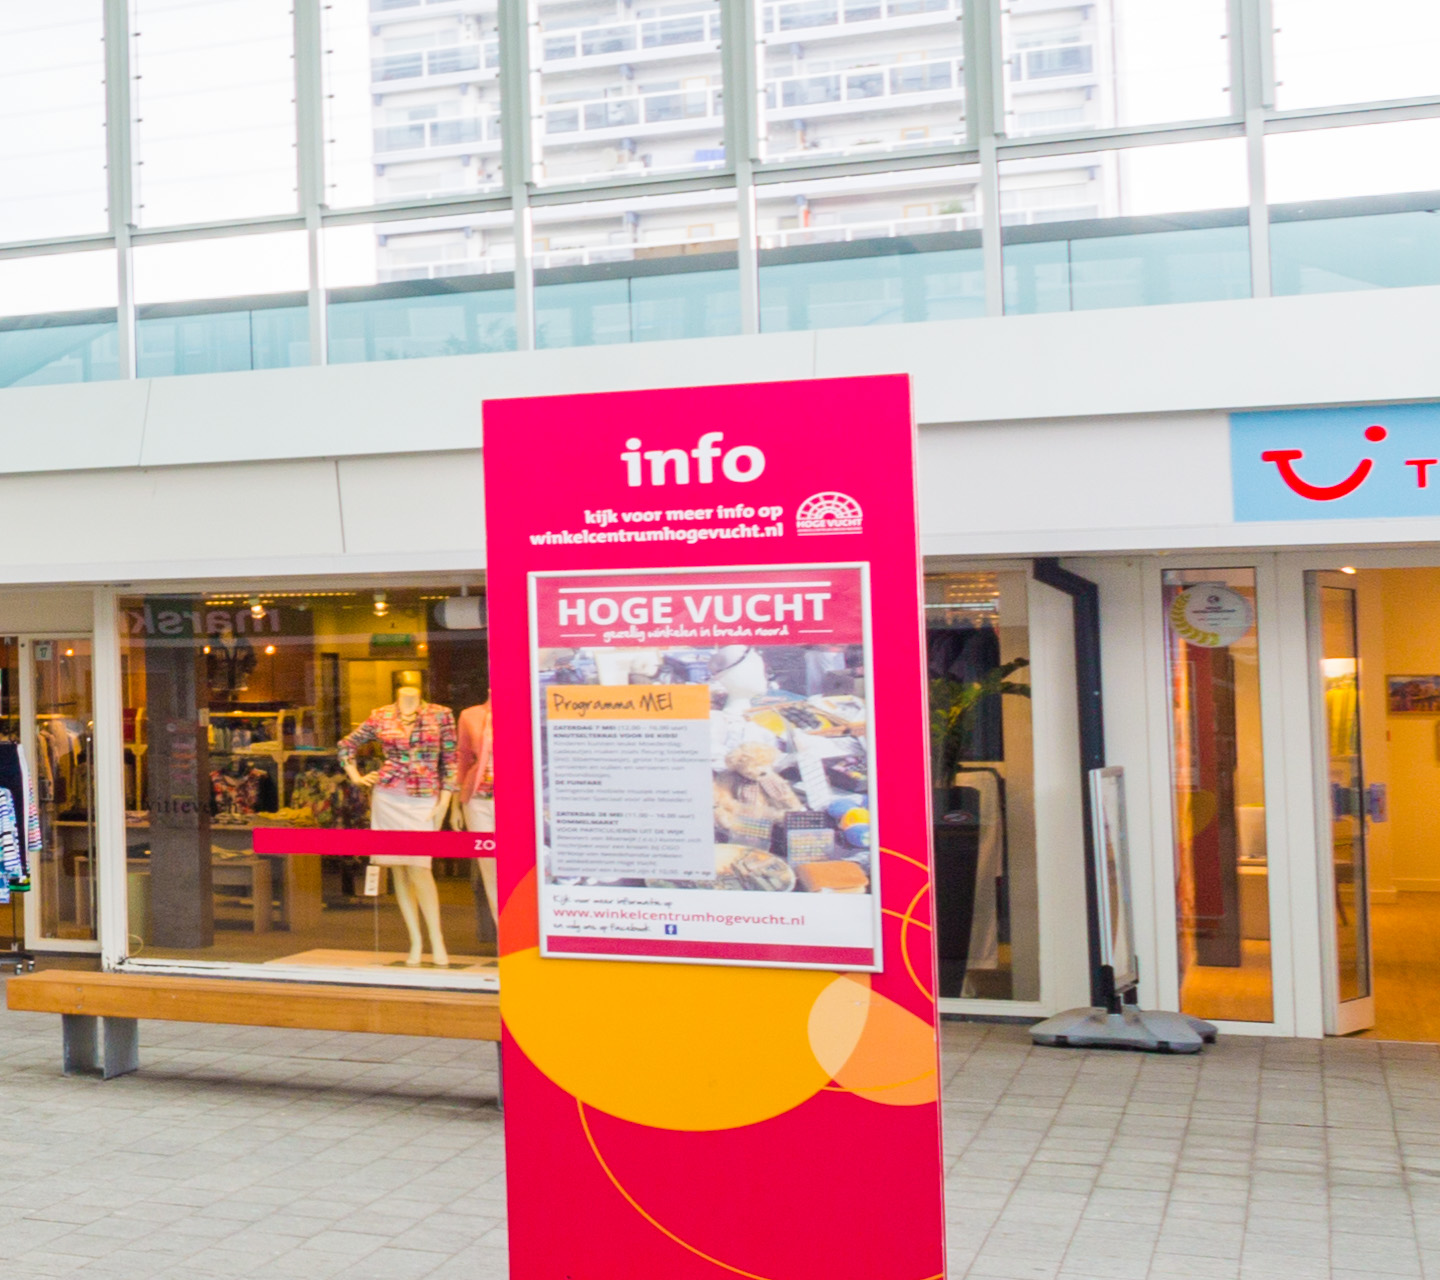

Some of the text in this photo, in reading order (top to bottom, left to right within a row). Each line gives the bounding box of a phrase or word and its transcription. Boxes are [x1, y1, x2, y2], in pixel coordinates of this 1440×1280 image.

[620, 431, 766, 487] info
[584, 503, 784, 528] kijk voor meer info op
[530, 522, 784, 545] winkelcentrumhogevucht.nl
[558, 592, 831, 626] HOGE VUCHT
[603, 624, 790, 643] gezellig winkelen in breda noord
[553, 692, 673, 717] Programma MEI
[553, 907, 805, 926] www.winkelcentrumhogevucht.nl
